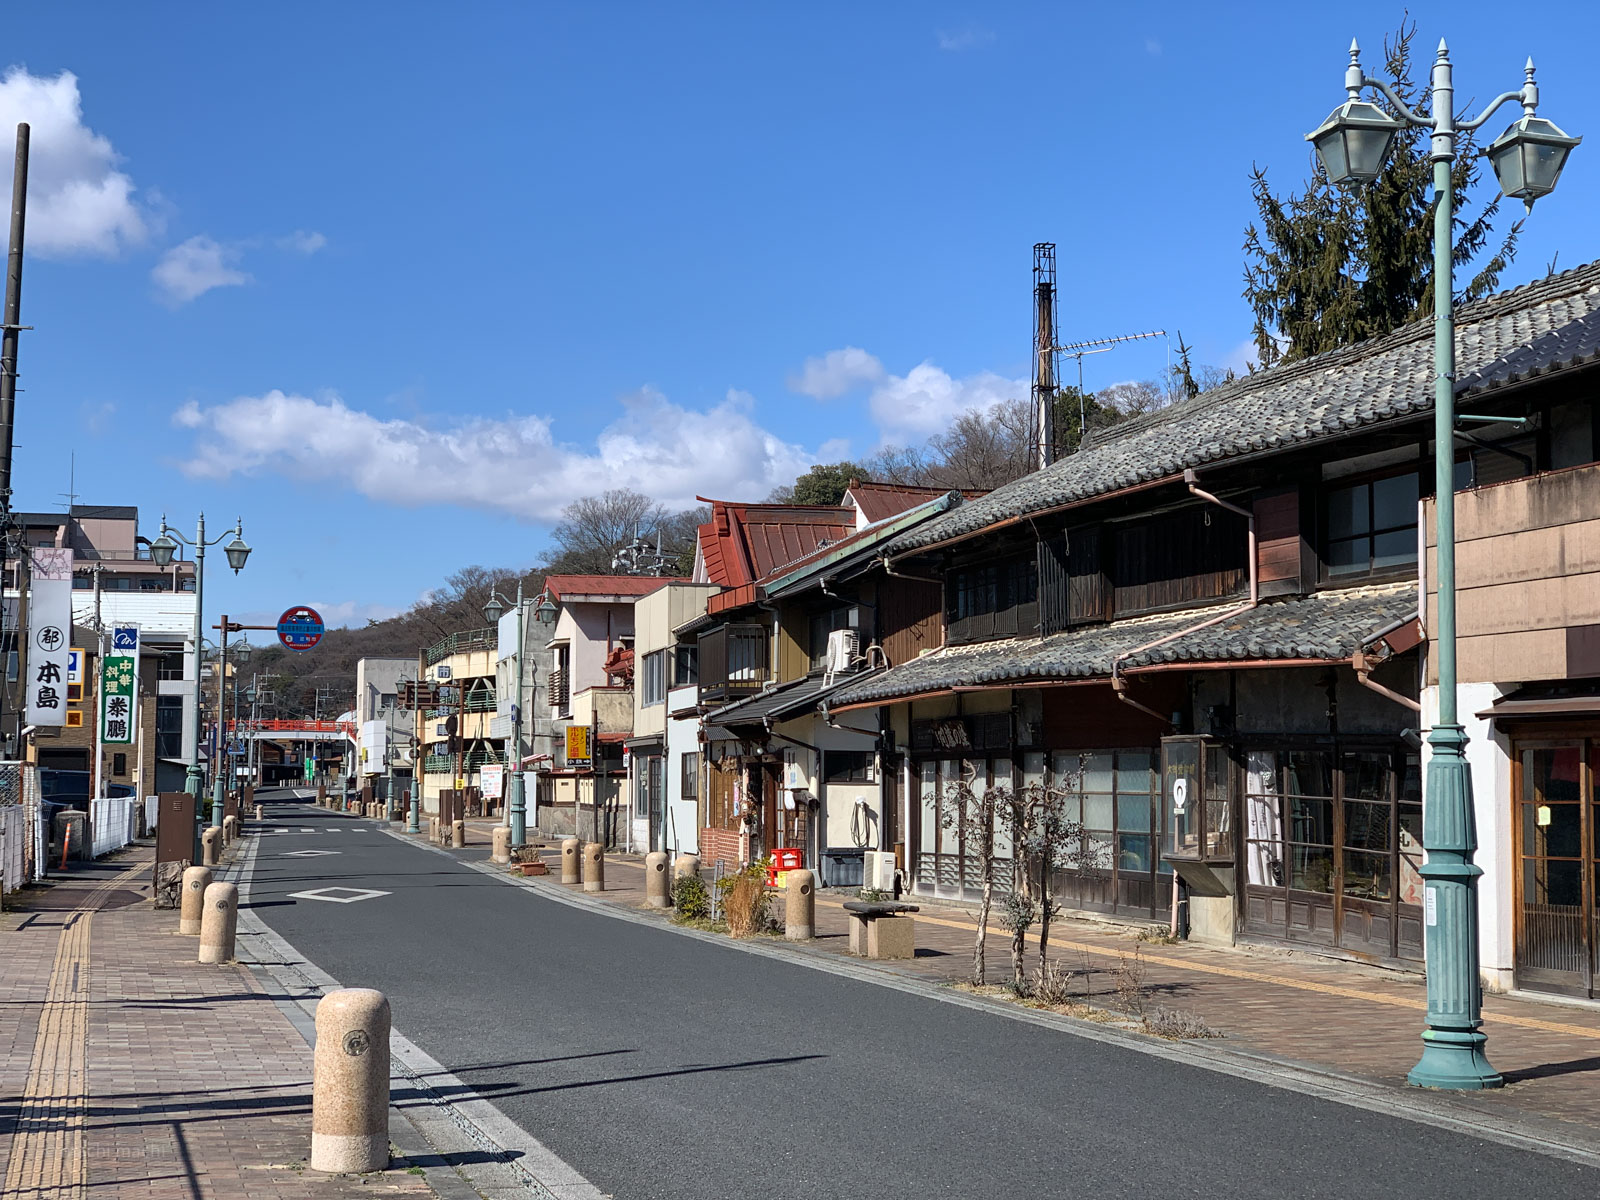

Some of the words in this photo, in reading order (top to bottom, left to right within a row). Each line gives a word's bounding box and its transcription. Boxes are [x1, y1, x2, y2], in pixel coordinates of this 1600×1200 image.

[40, 628, 60, 650] 都
[36, 660, 61, 710] 本島
[105, 665, 119, 693] 料理
[119, 659, 133, 687] 中華
